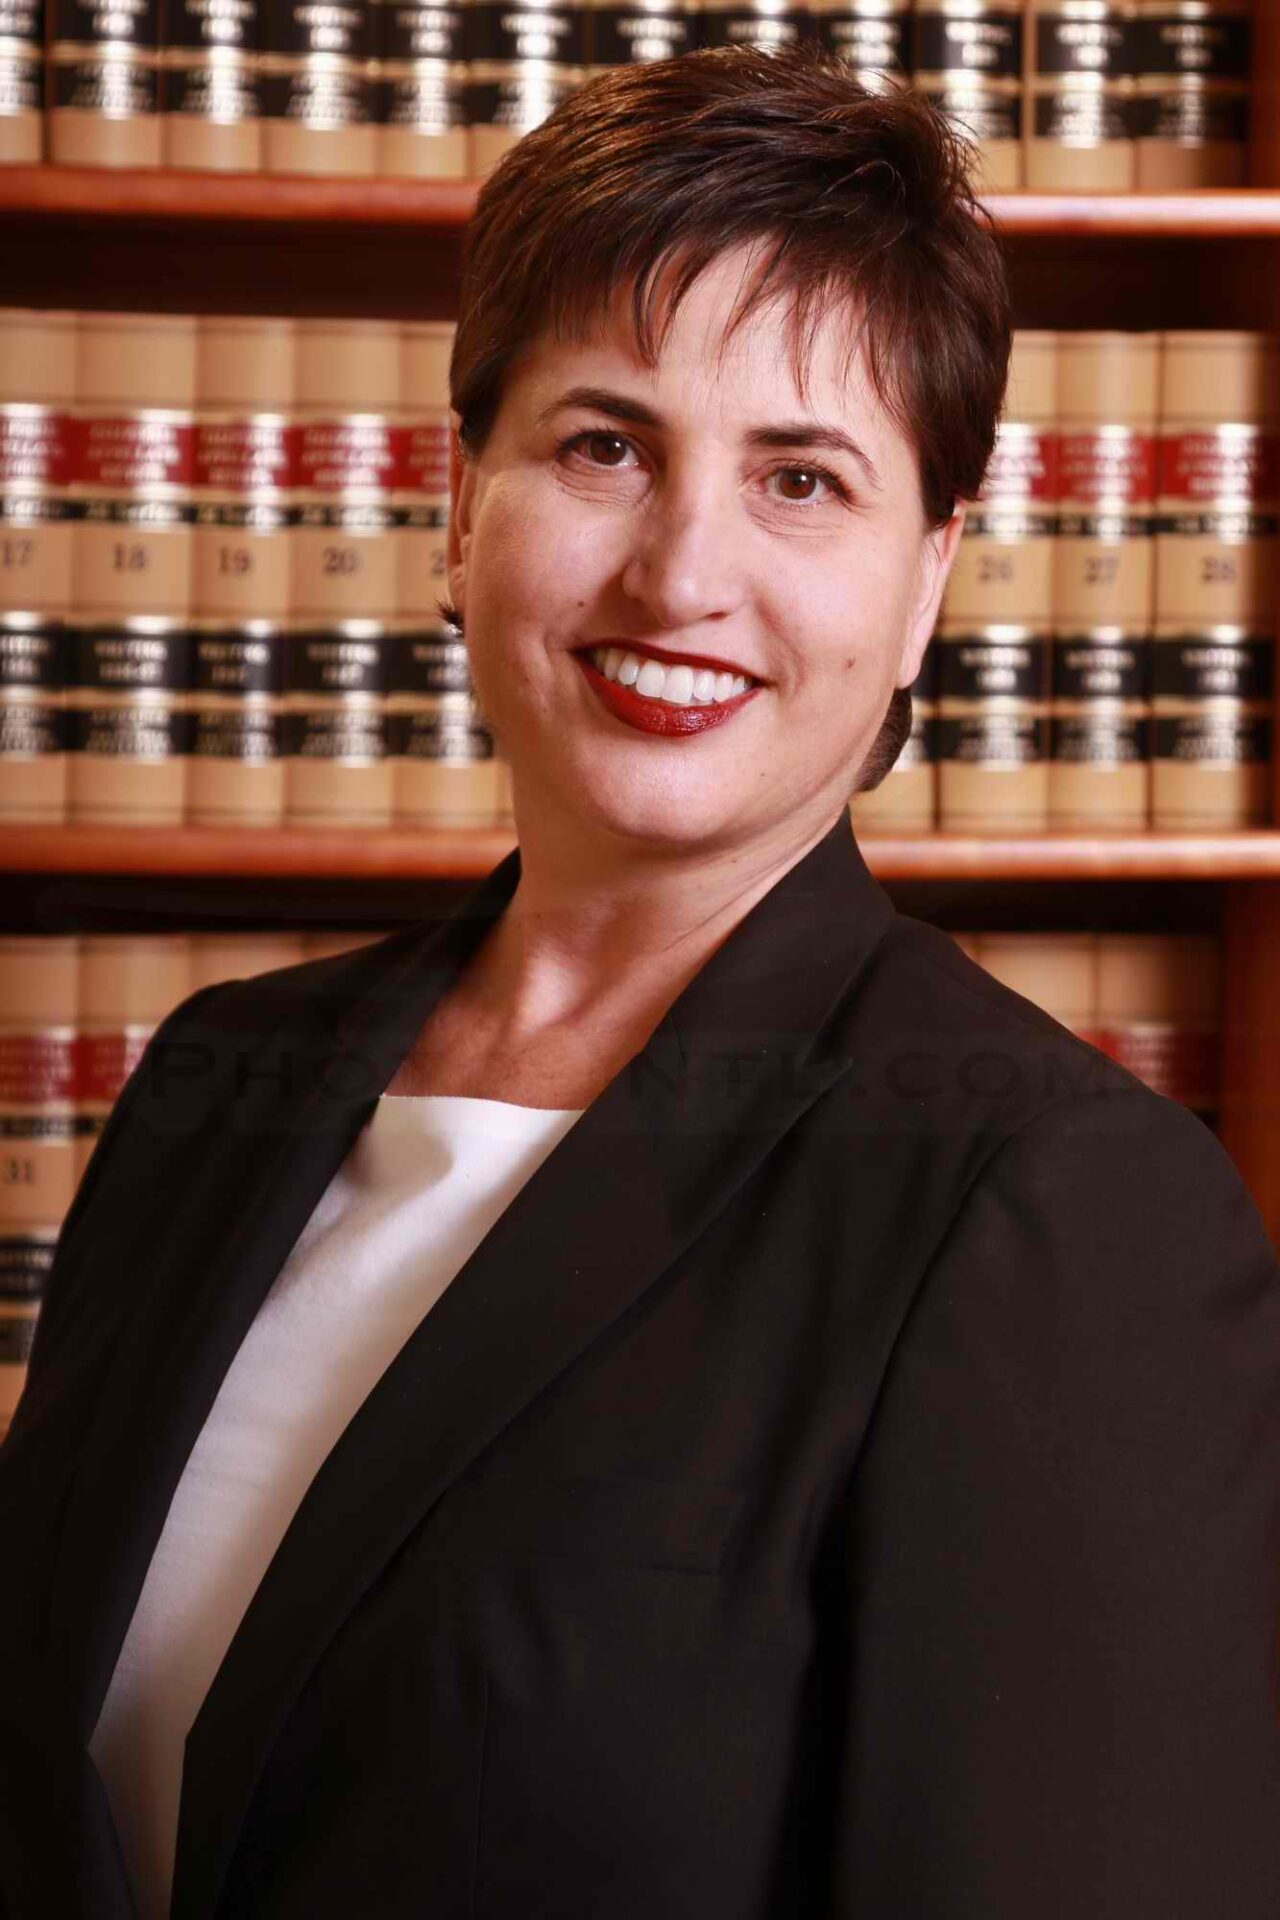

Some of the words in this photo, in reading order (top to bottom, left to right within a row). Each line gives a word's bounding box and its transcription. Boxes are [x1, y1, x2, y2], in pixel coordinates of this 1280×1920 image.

[113, 543, 147, 573] 18
[218, 547, 251, 575] 19
[323, 547, 362, 576] 20
[1085, 556, 1119, 586] 27
